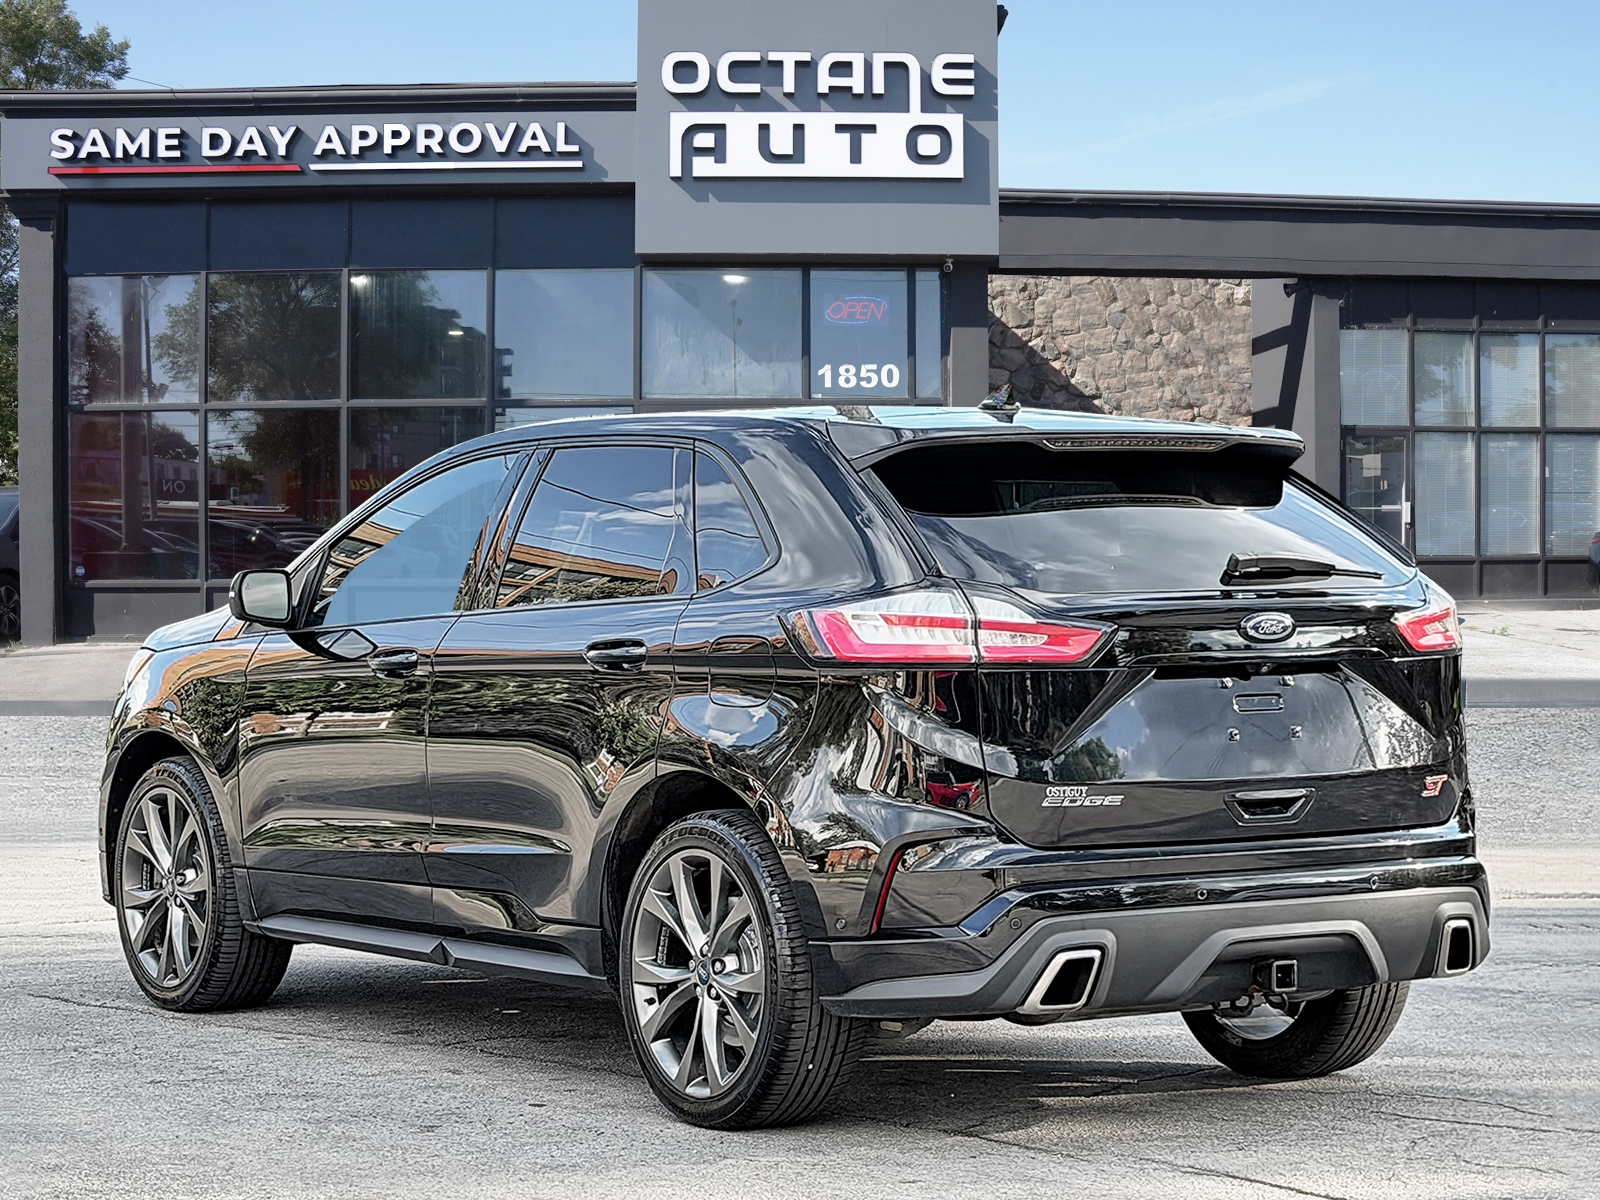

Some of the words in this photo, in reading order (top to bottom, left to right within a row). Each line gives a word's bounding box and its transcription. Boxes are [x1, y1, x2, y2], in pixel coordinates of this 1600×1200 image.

[661, 50, 975, 97] OCTANE
[48, 126, 181, 160] SAME
[200, 124, 299, 158] DAY
[312, 121, 580, 156] APPROVAL
[681, 123, 953, 178] AUTO
[829, 302, 885, 319] OPEN
[817, 363, 900, 388] 1850
[1046, 786, 1089, 797] OSTIGUY
[1420, 773, 1449, 798] ST
[1041, 795, 1125, 807] EDGE
